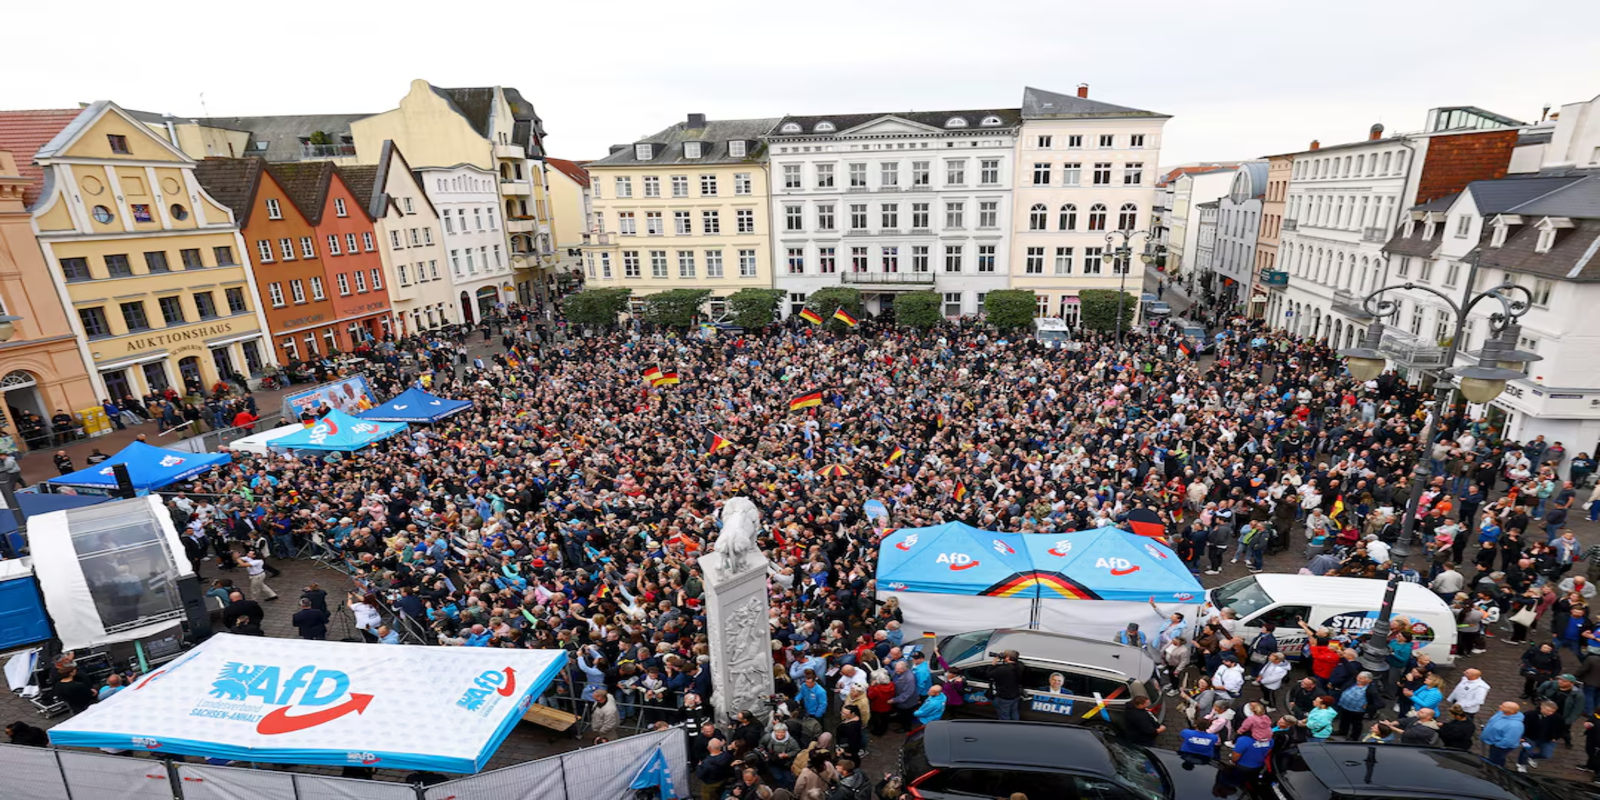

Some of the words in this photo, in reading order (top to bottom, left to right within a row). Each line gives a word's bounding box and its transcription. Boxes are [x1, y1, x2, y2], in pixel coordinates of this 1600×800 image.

[127, 323, 232, 351] AUKTIONSHAUS
[1505, 383, 1524, 399] EDE
[935, 552, 971, 564] AfD
[1094, 557, 1132, 570] AfD
[888, 581, 905, 589] AfD
[1172, 592, 1192, 600] AfD
[247, 664, 351, 706] AfD
[467, 670, 504, 700] AfD
[196, 697, 264, 713] Landesverband
[1032, 701, 1072, 715] HOLM
[189, 708, 264, 723] SACHSEN-ANHALT
